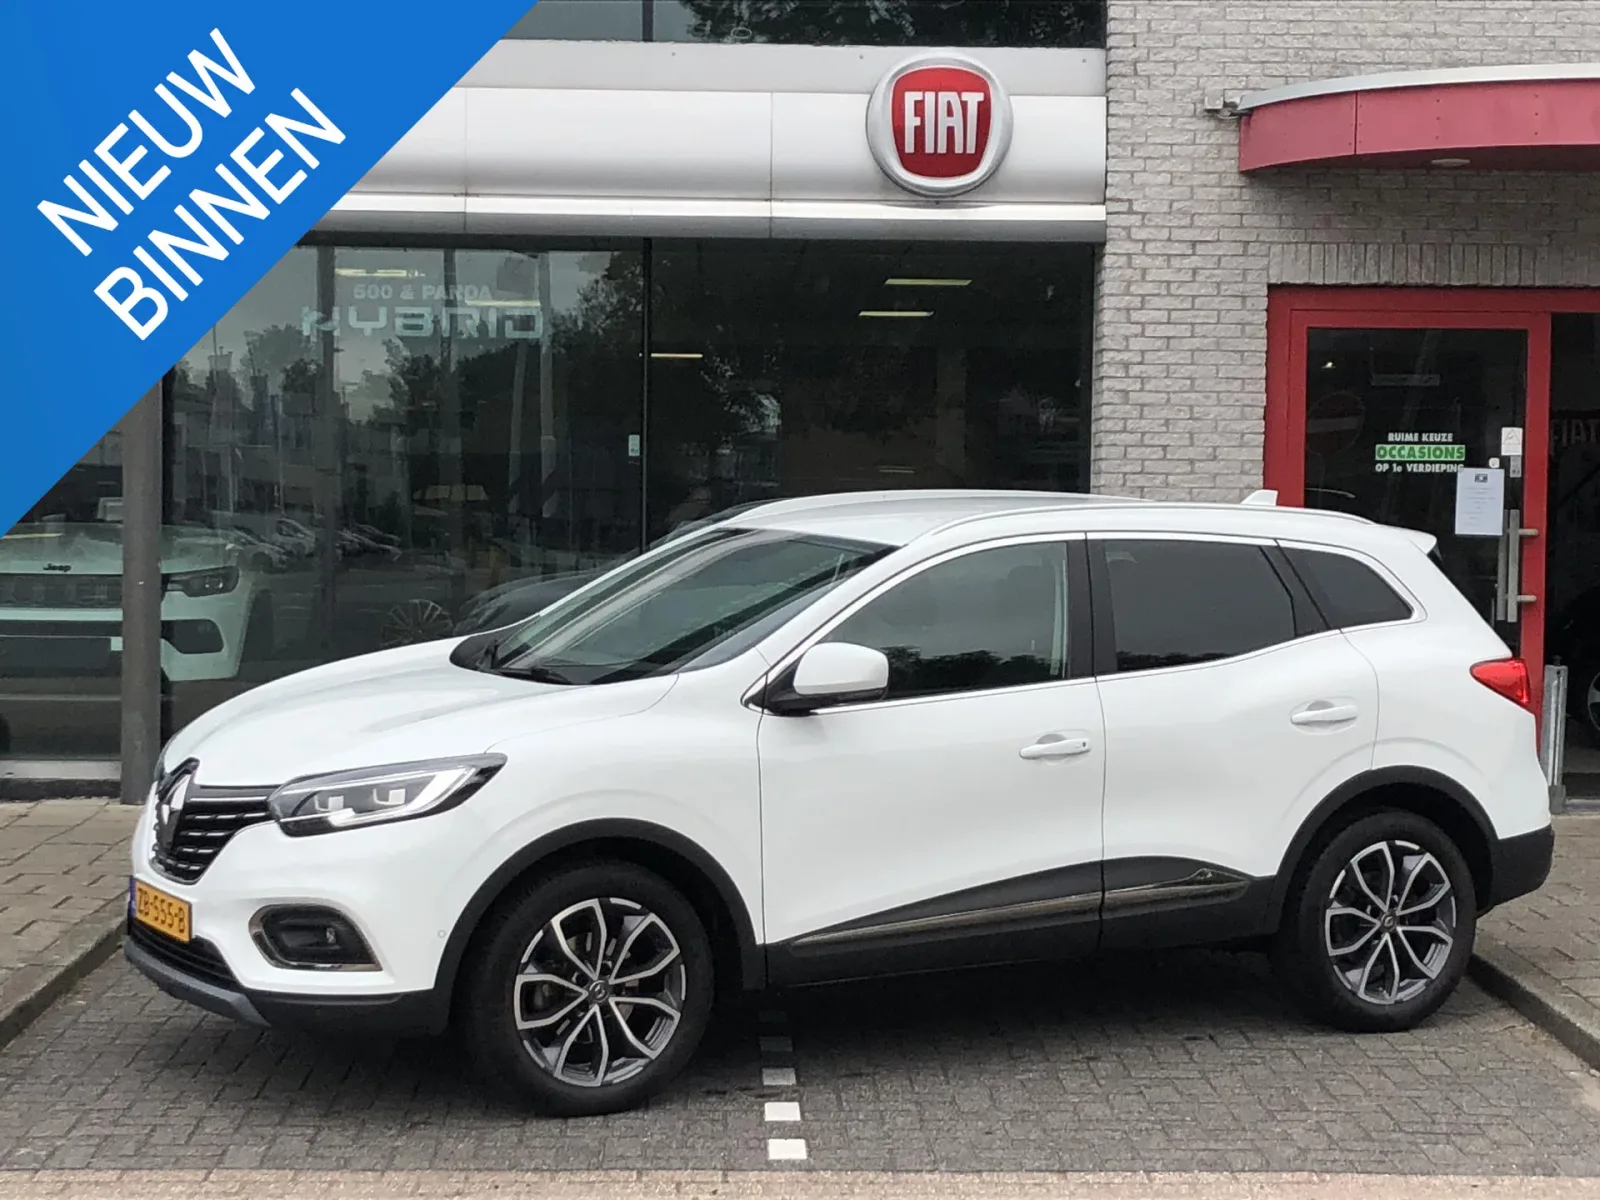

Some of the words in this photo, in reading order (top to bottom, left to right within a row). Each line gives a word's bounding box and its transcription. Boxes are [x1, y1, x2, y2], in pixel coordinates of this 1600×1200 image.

[904, 91, 985, 154] FIAT
[353, 284, 393, 300] 500
[400, 285, 416, 300] &
[422, 284, 492, 301] PANDA
[301, 306, 543, 339] HYBRID
[1388, 432, 1419, 442] RUIME
[1421, 432, 1453, 442] KEUZE
[1377, 446, 1464, 459] OCCASIONS
[1375, 463, 1389, 473] OP
[1393, 463, 1402, 473] 1e
[43, 563, 71, 572] Jeep
